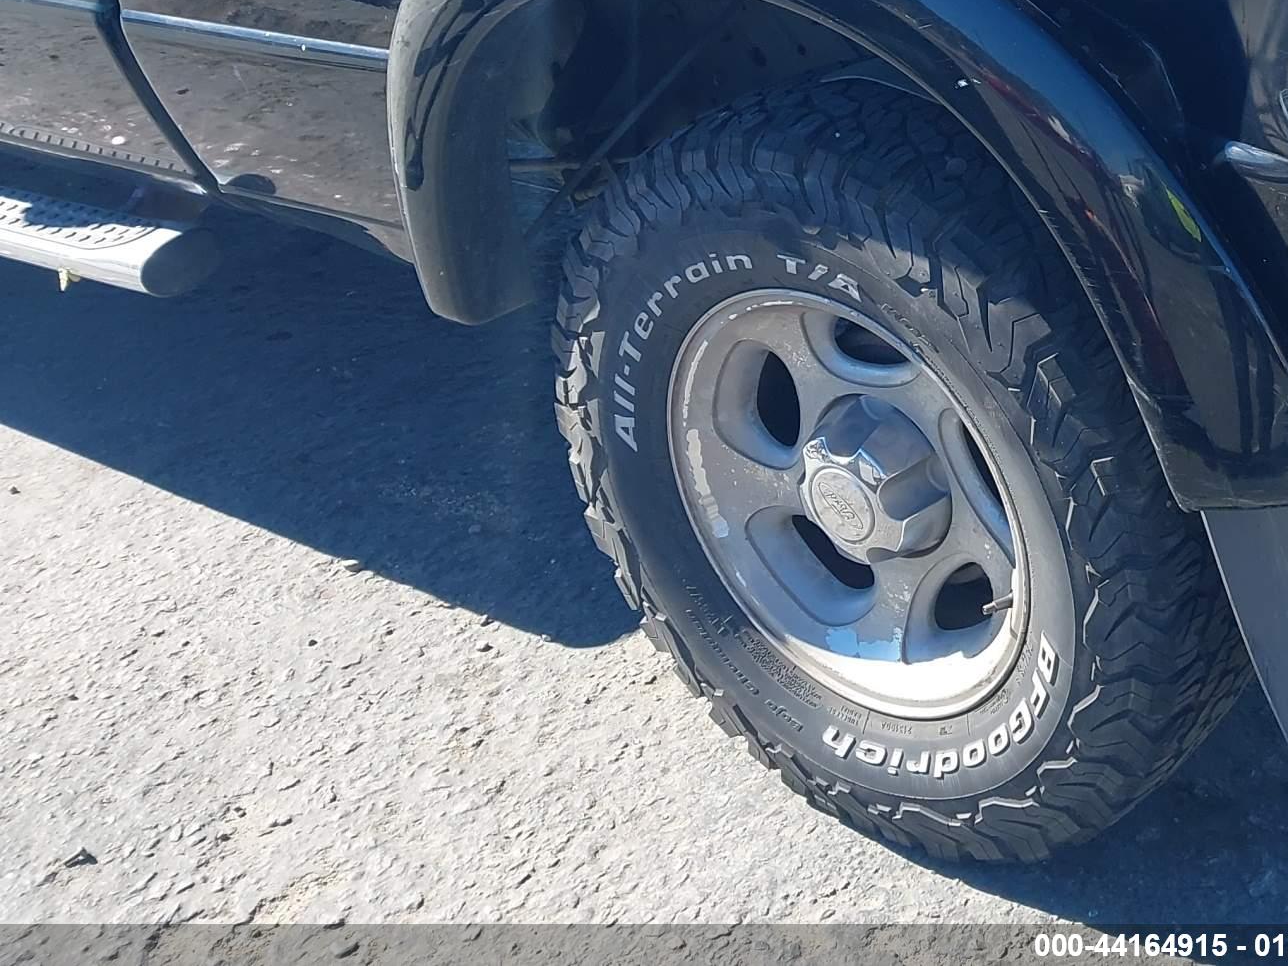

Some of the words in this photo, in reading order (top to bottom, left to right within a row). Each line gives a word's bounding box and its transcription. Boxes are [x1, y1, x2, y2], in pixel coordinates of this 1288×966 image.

[614, 252, 753, 453] All-Terrain
[776, 253, 863, 303] T/A
[822, 631, 1058, 779] BFGoodrich
